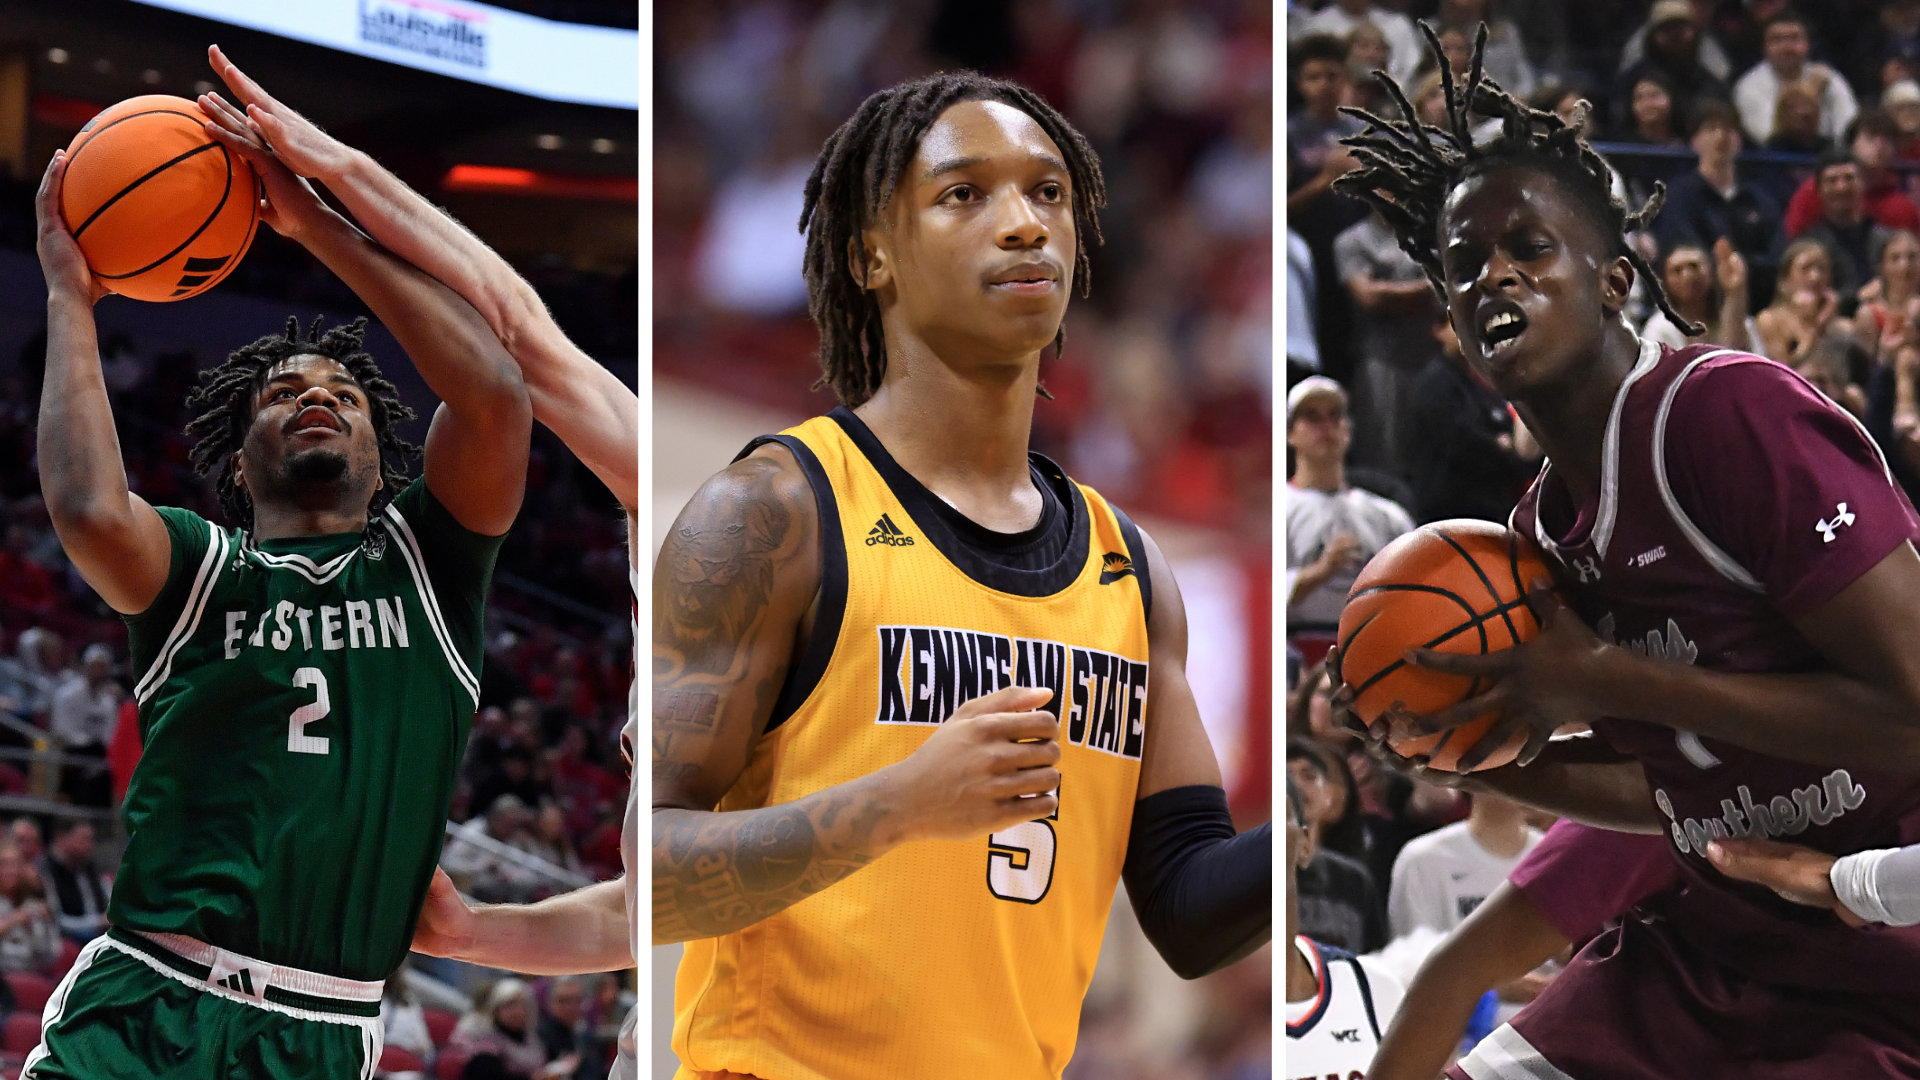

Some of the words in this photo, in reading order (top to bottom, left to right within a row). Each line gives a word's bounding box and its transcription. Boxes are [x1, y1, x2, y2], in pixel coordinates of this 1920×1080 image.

[865, 532, 915, 547] adidas
[1637, 545, 1667, 567] SWAC
[287, 666, 331, 755] 2
[1067, 644, 1149, 762] STATE
[986, 773, 1062, 905] 5
